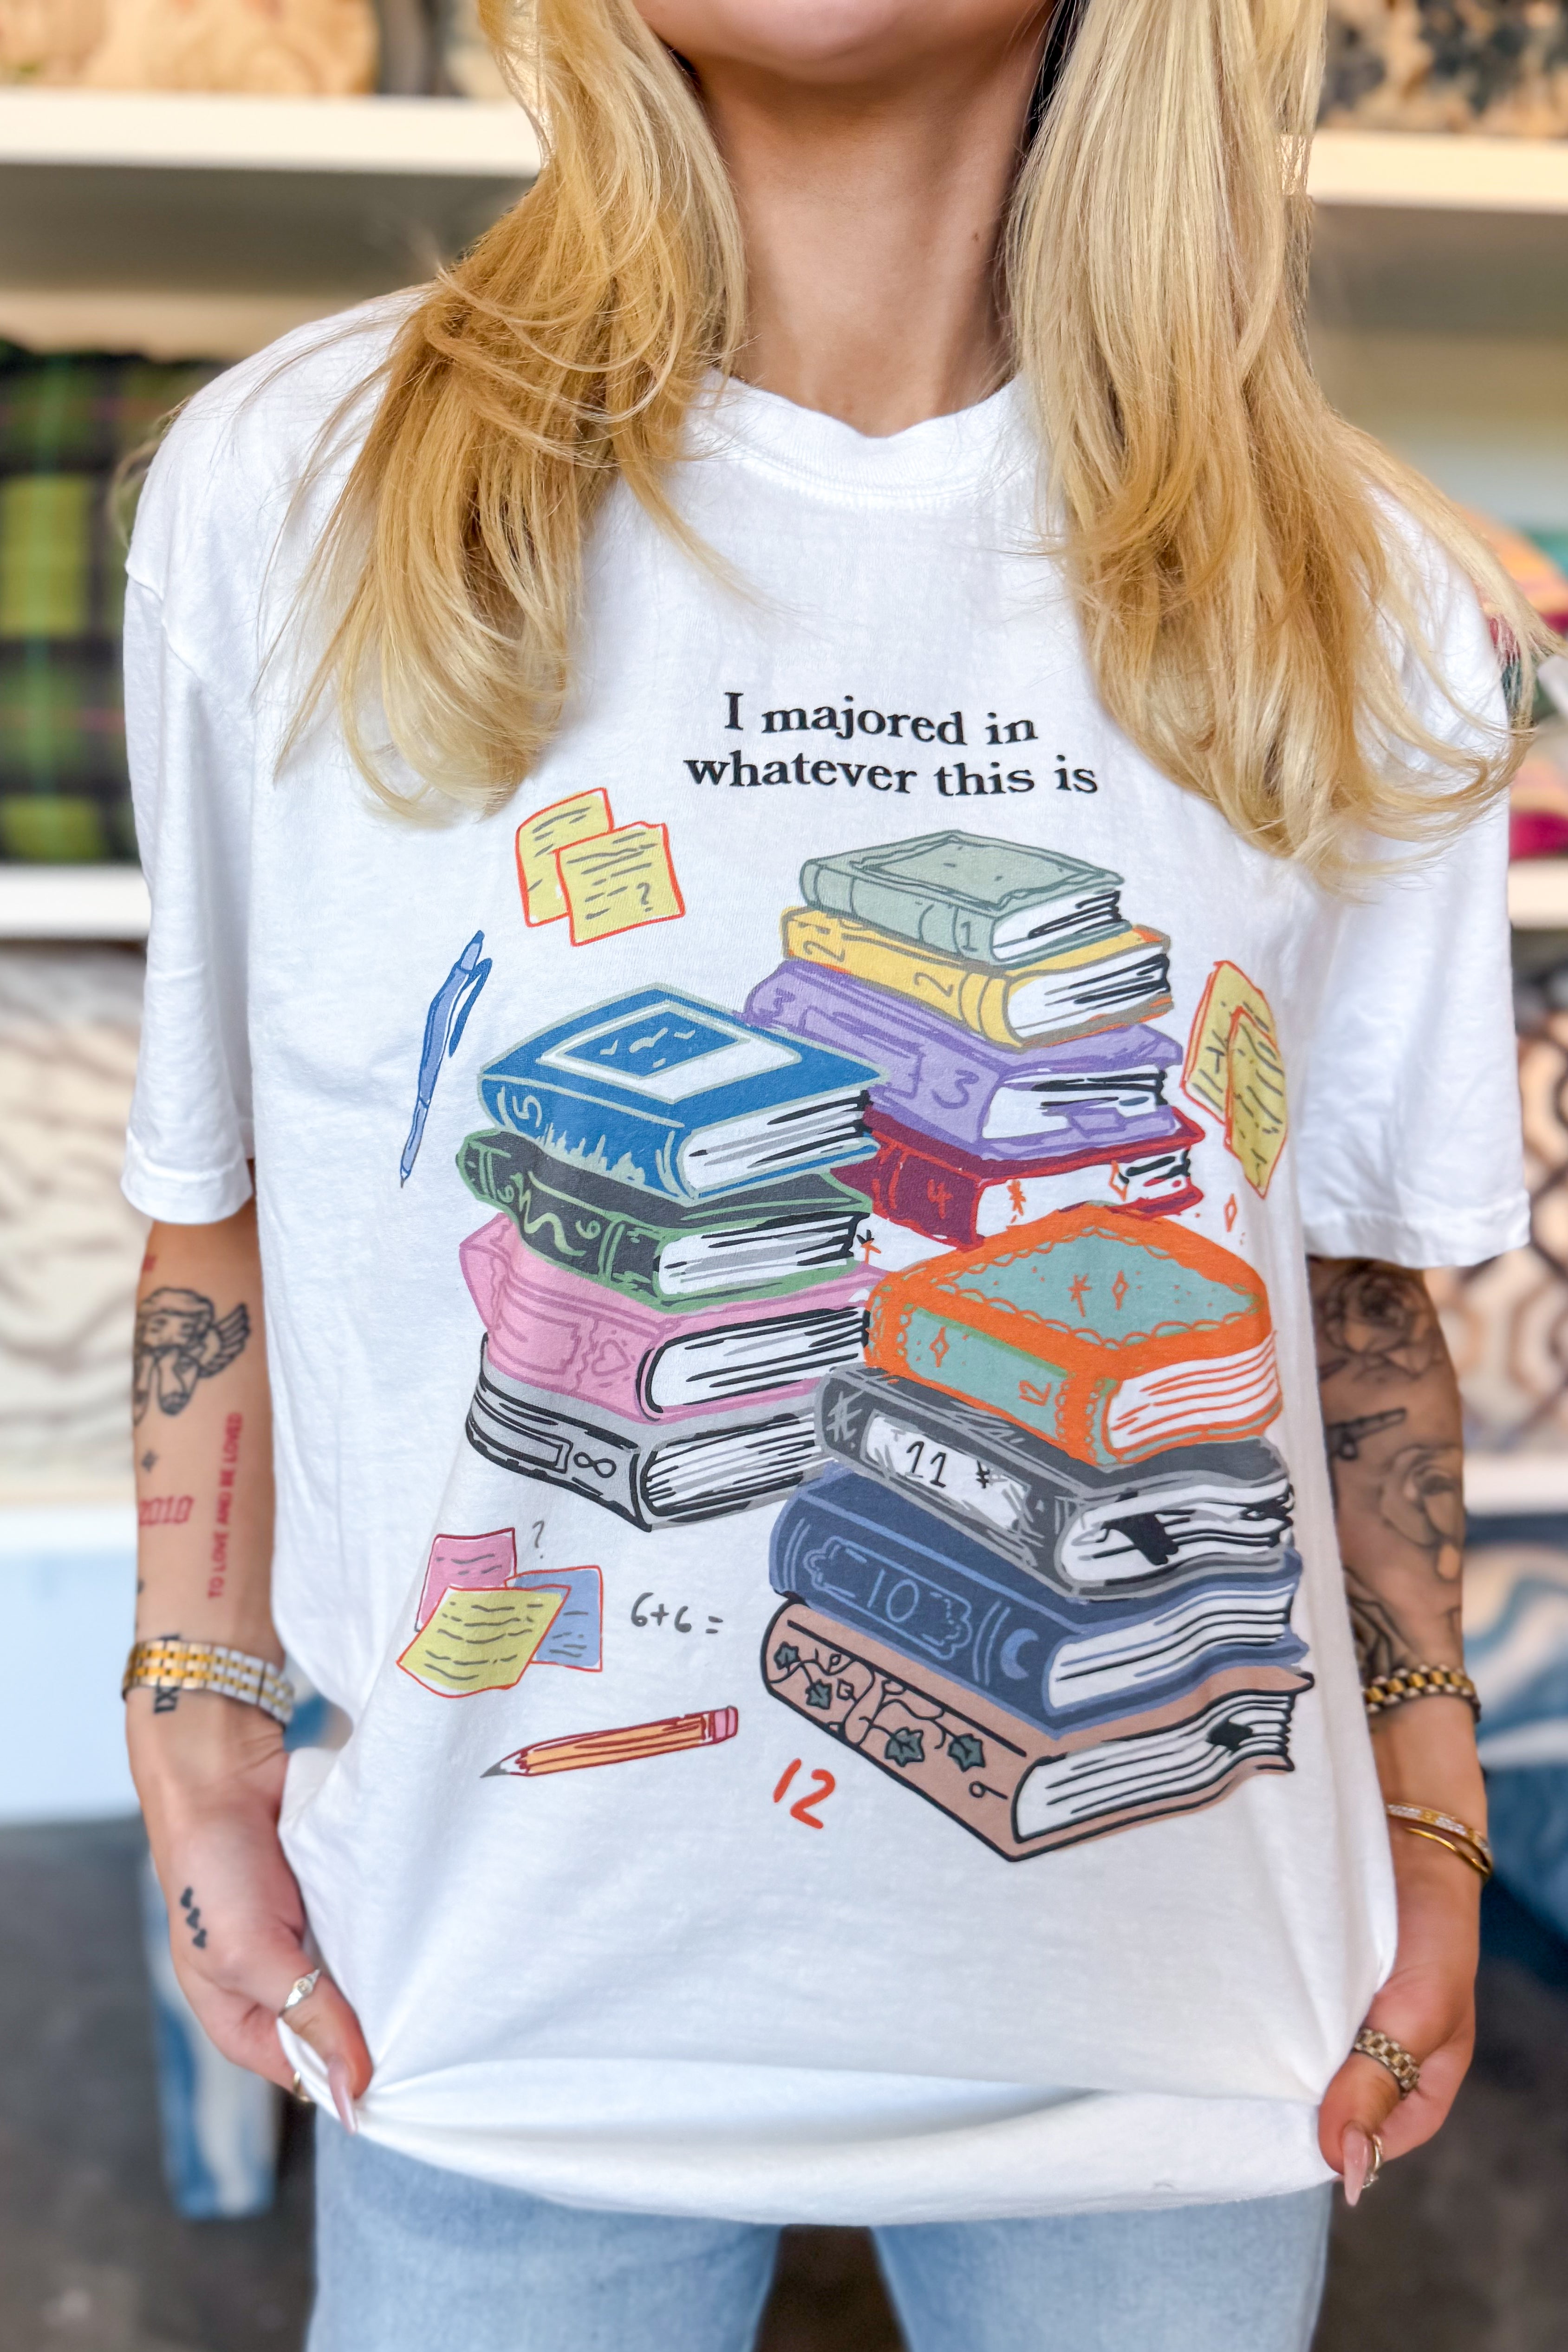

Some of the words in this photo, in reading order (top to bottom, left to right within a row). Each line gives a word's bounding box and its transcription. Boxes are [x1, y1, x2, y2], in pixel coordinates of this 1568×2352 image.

[724, 691, 744, 731] I
[761, 695, 968, 746] majored
[985, 711, 1039, 745] in
[683, 749, 918, 794] whatever
[933, 761, 1035, 797] this
[1054, 754, 1099, 794] is
[866, 1569, 919, 1622] 10
[772, 1757, 836, 1829] 12
